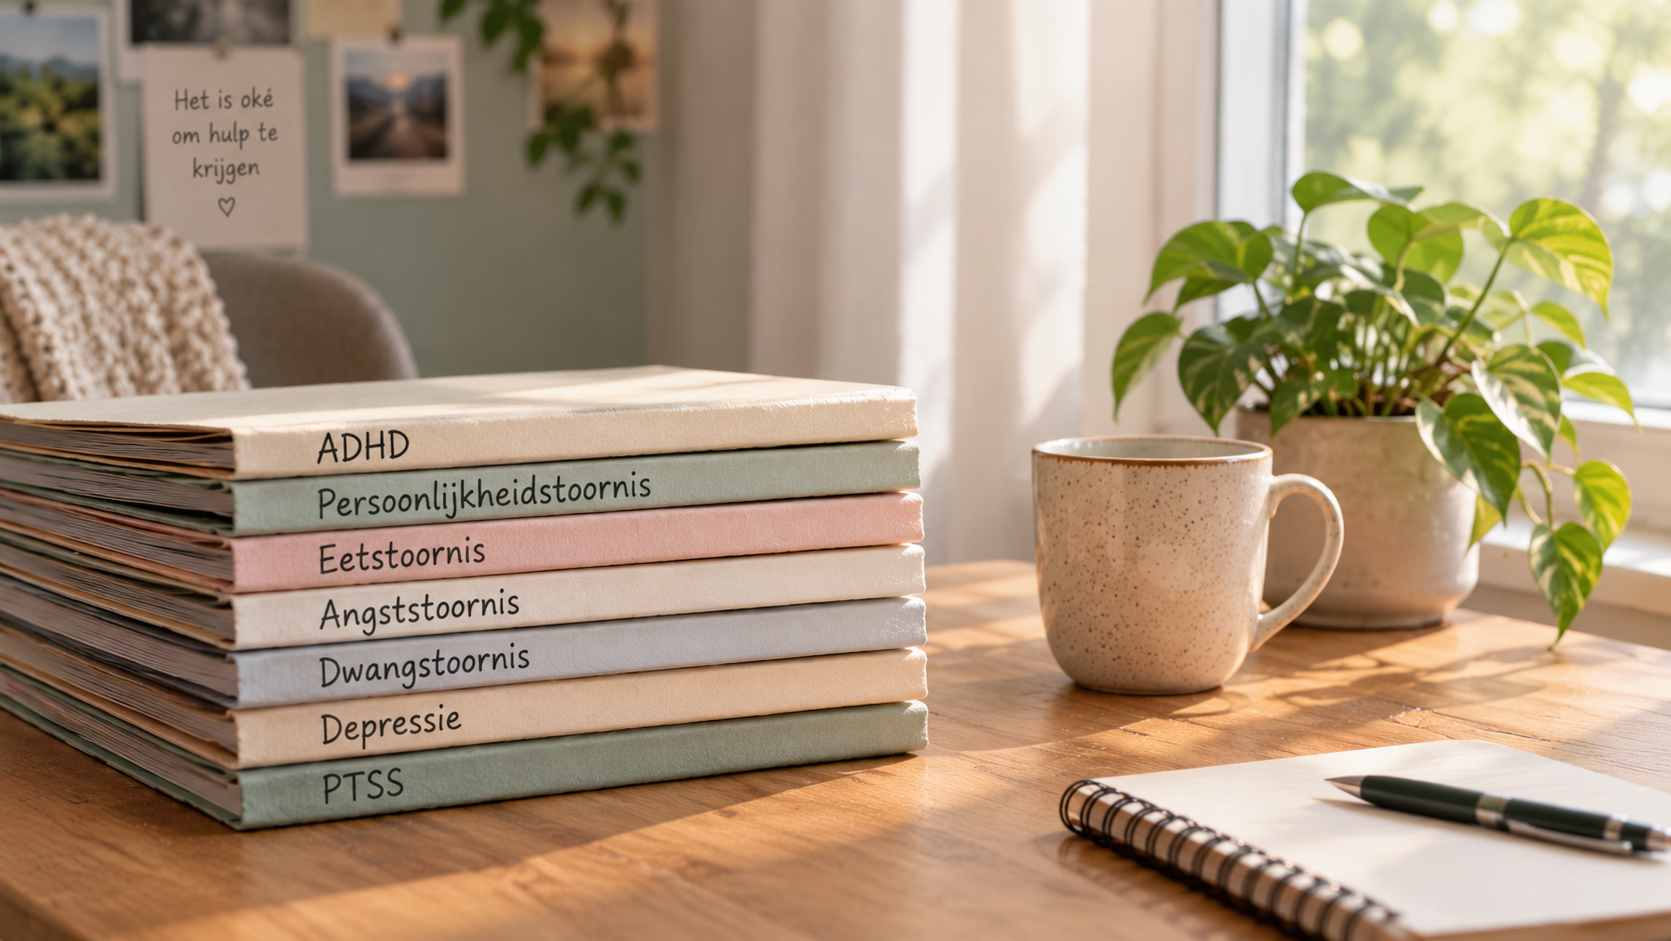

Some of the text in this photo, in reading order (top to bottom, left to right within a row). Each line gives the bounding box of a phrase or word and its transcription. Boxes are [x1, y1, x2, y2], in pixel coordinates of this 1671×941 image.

[172, 87, 273, 111] Het is oké
[171, 122, 278, 150] om hulp te
[191, 156, 260, 185] krijgen
[317, 429, 410, 465] ADHD
[317, 470, 652, 521] Persoonlijkheidstoornis
[319, 535, 486, 575] Eetstoornis
[319, 587, 520, 637] Angststoornis
[319, 641, 530, 691] Dwangstoornis
[320, 703, 463, 750] Depressie
[322, 767, 404, 805] PTSS
